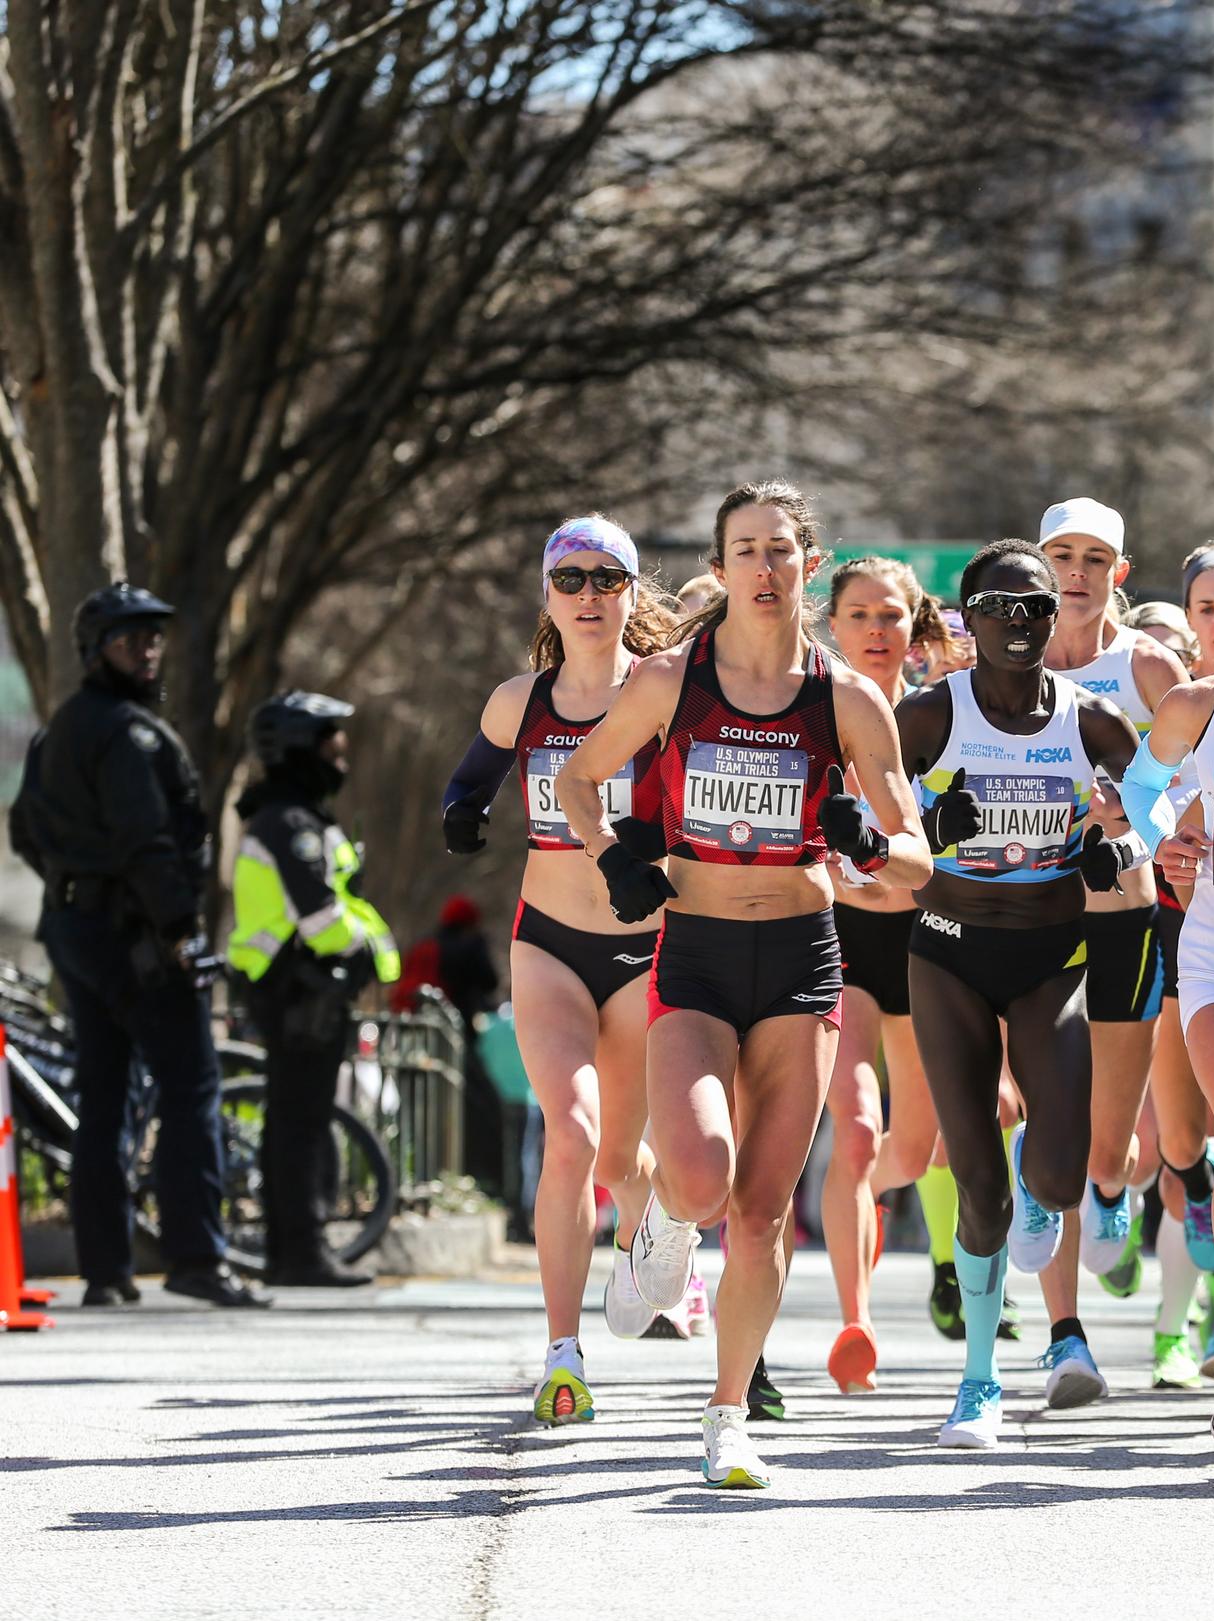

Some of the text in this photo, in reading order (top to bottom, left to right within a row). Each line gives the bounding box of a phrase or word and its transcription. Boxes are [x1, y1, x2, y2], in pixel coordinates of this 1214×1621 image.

[1081, 680, 1120, 693] OKA
[543, 734, 586, 746] sauc
[719, 726, 800, 748] saucony
[961, 742, 1004, 753] NORTHERN
[549, 752, 567, 764] U.S.
[716, 748, 779, 764] U.S. OLYMPIC
[960, 750, 1016, 761] ARIZONA ELITE
[1025, 747, 1073, 763] HOKA
[715, 760, 778, 777] TEAM TRIALS
[790, 761, 799, 770] 15
[986, 778, 1046, 790] U.S. OLYMPIC
[689, 775, 801, 817] THWEATT
[986, 790, 1046, 802] TEAM TRIALS
[976, 808, 1068, 836] ULIAMUK
[920, 910, 962, 938] HOKA
